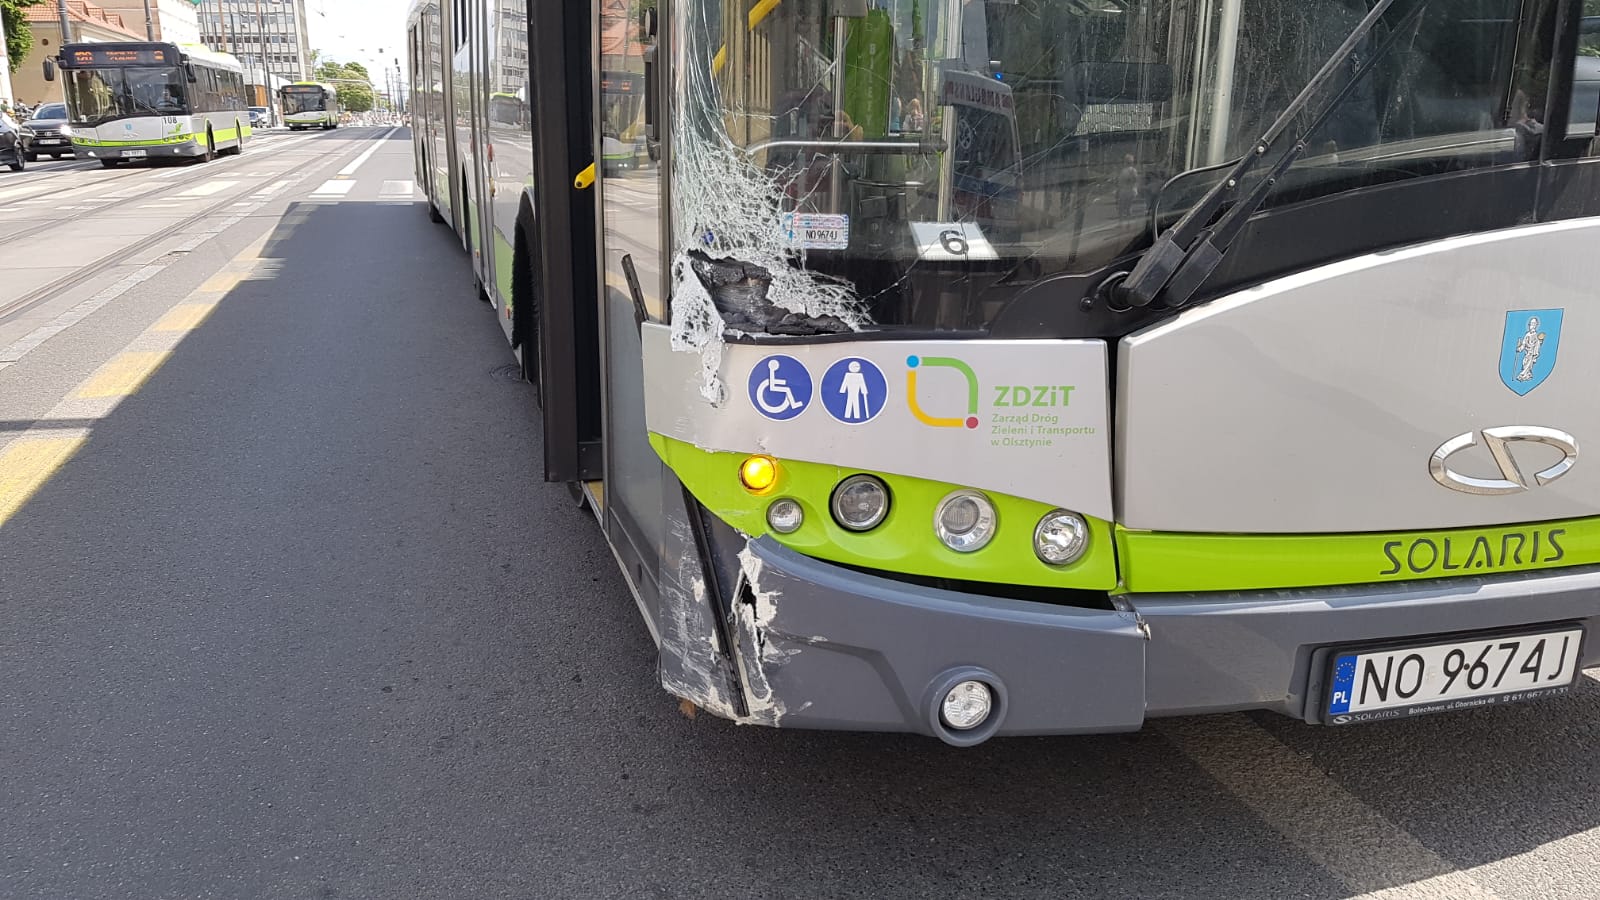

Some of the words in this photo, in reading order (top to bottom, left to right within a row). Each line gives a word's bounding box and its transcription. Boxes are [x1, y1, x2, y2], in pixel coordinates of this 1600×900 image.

[163, 117, 177, 125] 108
[805, 229, 816, 240] NO
[817, 229, 838, 241] 9674J
[939, 229, 970, 256] 6
[992, 385, 1076, 407] ZDZiT
[991, 413, 1029, 425] Zarząd
[1031, 412, 1059, 425] Dróg
[991, 425, 1028, 435] Zieleni
[1030, 425, 1035, 435] i
[1037, 425, 1096, 437] Transportu
[991, 438, 1000, 447] w
[1002, 437, 1053, 449] Olsztynie
[1380, 528, 1566, 575] SOLARIS
[1358, 652, 1425, 705] NO
[1439, 635, 1570, 695] 9674J
[1332, 690, 1348, 705] PL
[1353, 709, 1401, 722] SOLARIS
